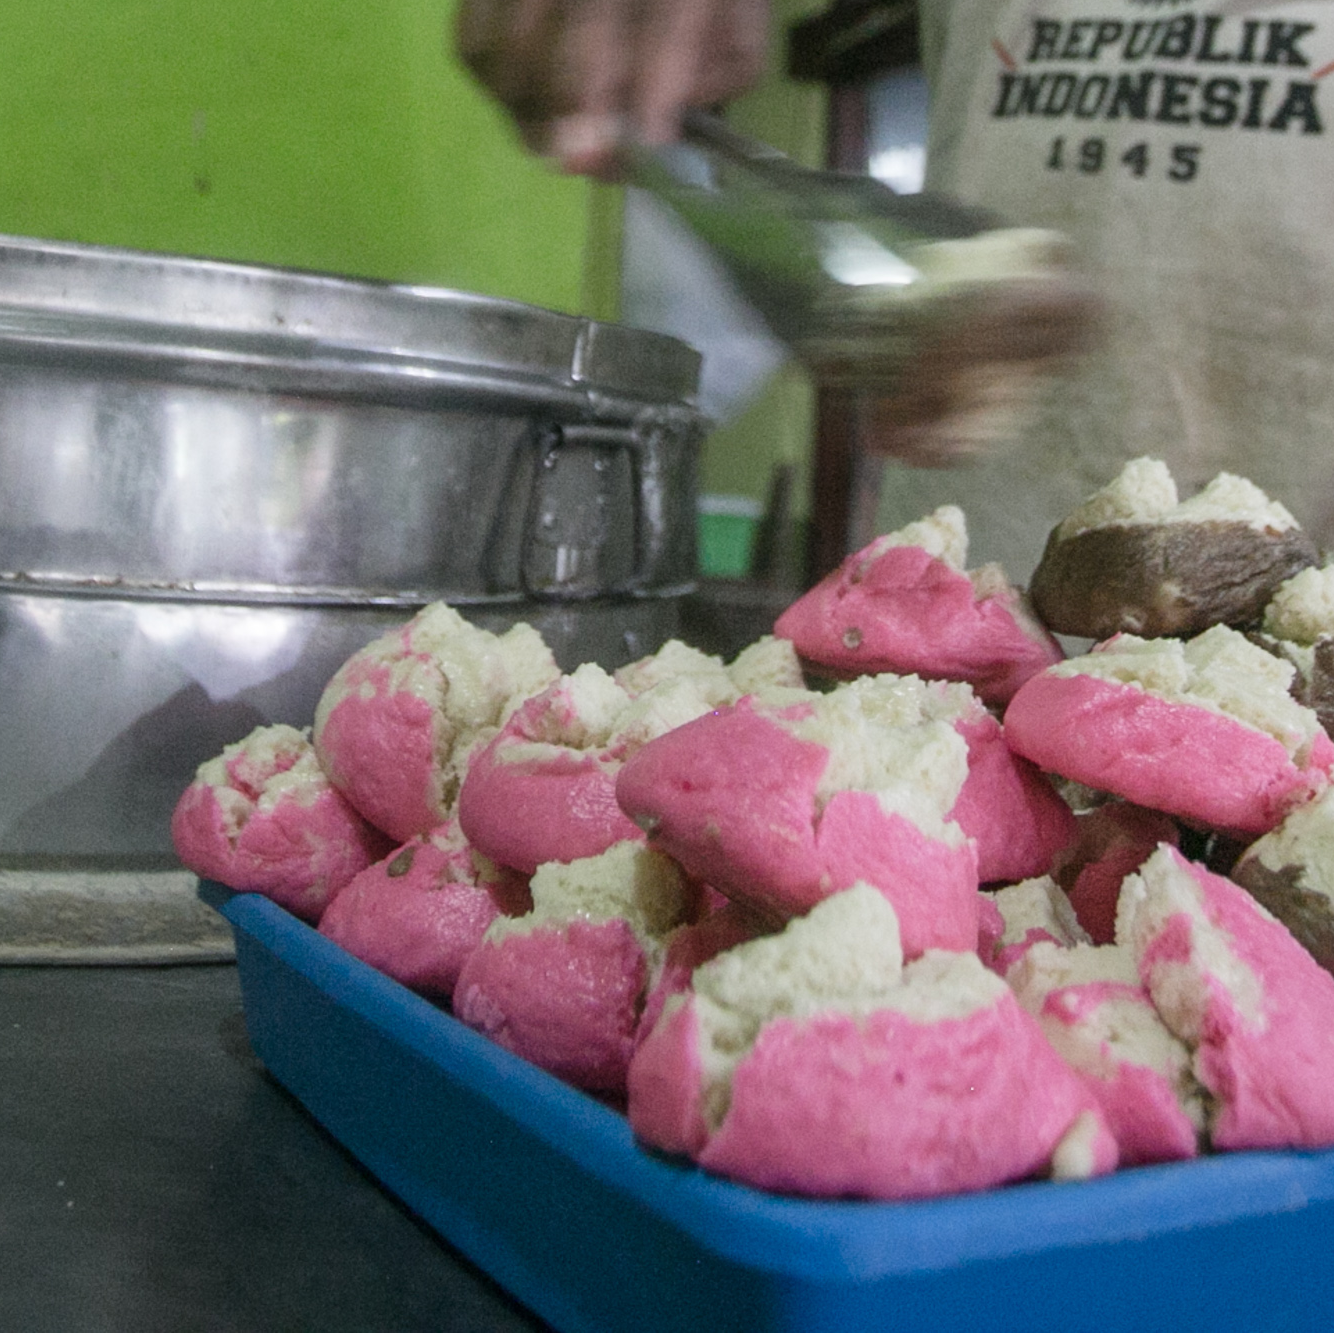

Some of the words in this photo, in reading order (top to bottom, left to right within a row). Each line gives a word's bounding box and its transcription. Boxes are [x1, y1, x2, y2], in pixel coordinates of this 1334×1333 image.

[1026, 12, 1315, 68] REPUBLIK
[992, 68, 1323, 135] INDONESIA
[1046, 136, 1203, 183] 1945
